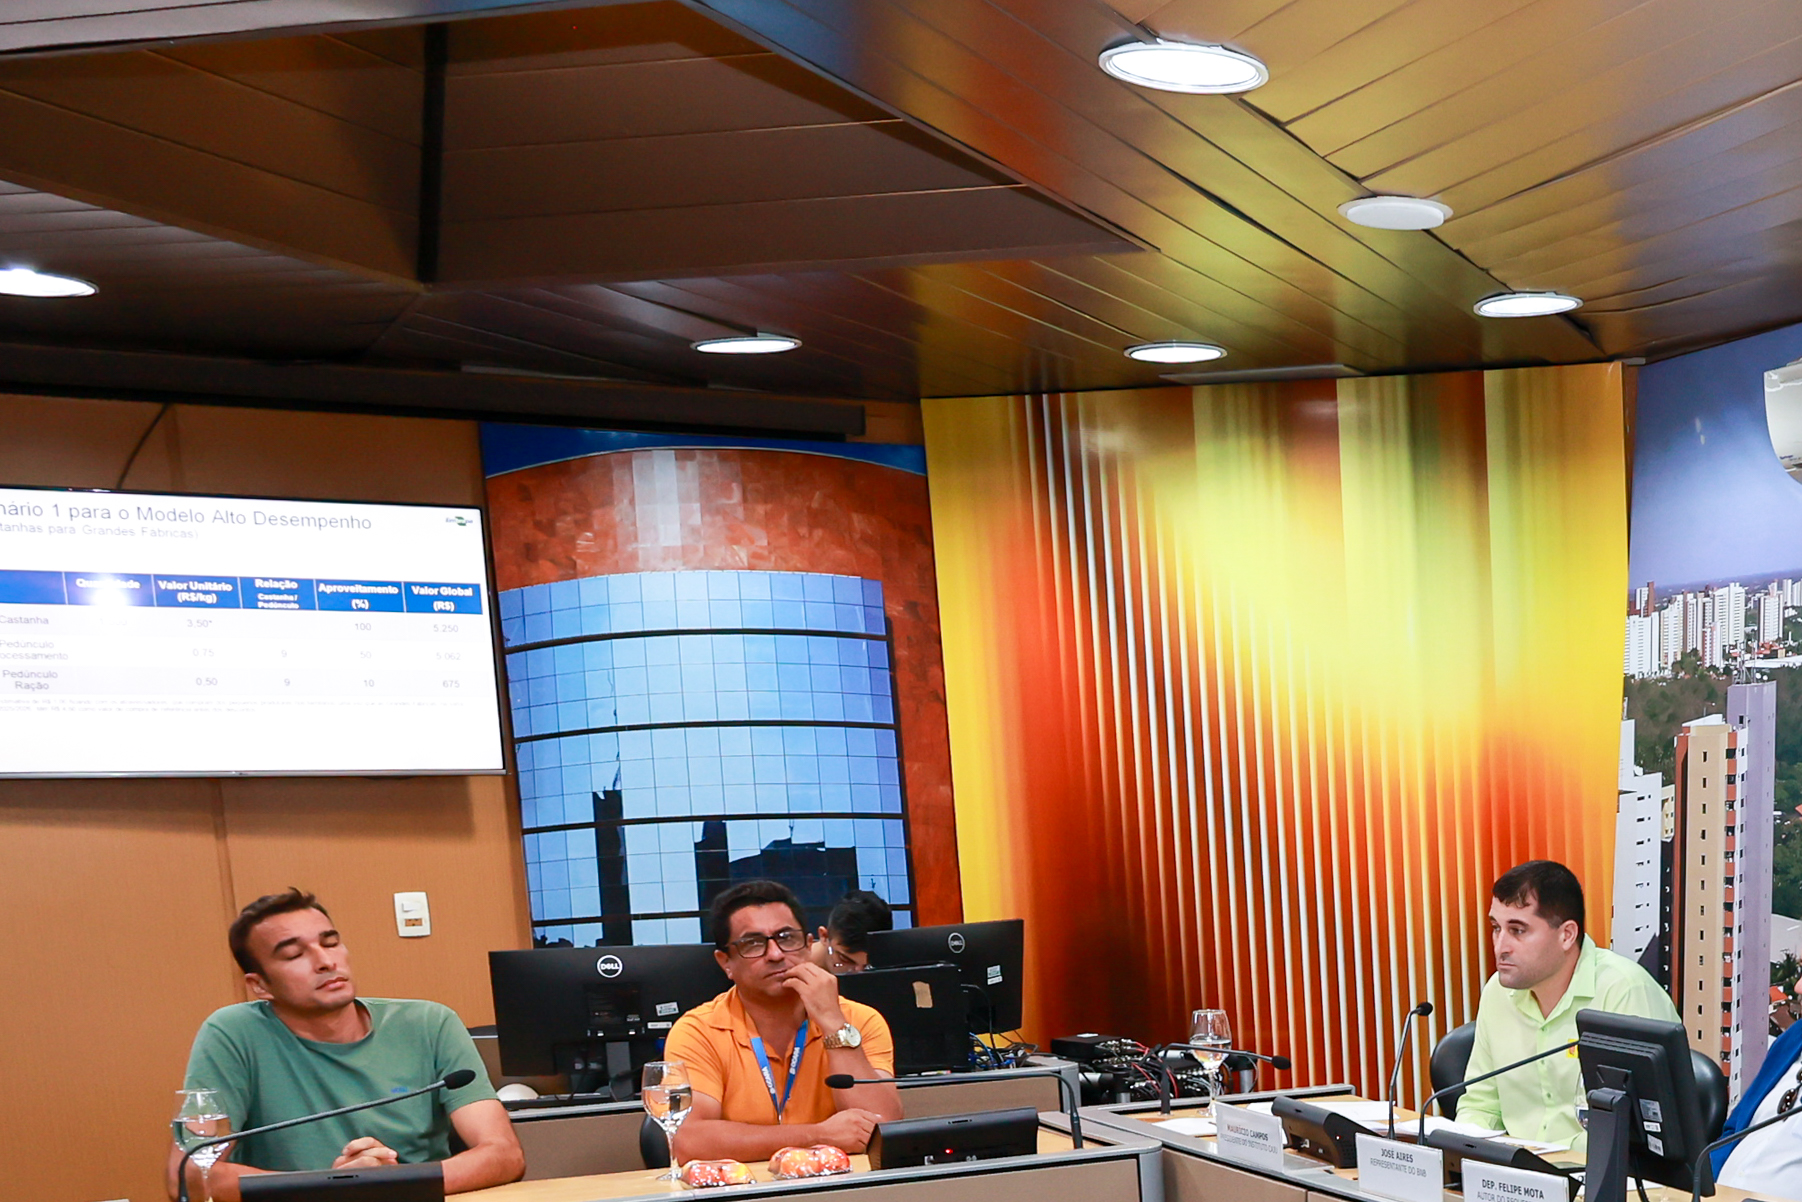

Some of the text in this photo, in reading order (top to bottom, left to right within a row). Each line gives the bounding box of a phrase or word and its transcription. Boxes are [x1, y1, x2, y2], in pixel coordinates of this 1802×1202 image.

[52, 504, 60, 518] 1
[69, 504, 111, 521] para
[118, 509, 130, 520] o
[137, 507, 205, 524] Modelo
[212, 510, 246, 525] Alto
[253, 511, 372, 531] Desempenho
[158, 580, 233, 592] Valor Unitário
[255, 579, 298, 590] Relação
[318, 583, 399, 595] Aproveitamento
[411, 586, 473, 597] Valor Global
[355, 623, 372, 631] 100
[15, 681, 50, 692] Ração
[442, 681, 460, 689] 675
[1381, 1147, 1414, 1163] JOSÉ AIRES
[1482, 1178, 1545, 1200] DEP. FELIPE MOTA
